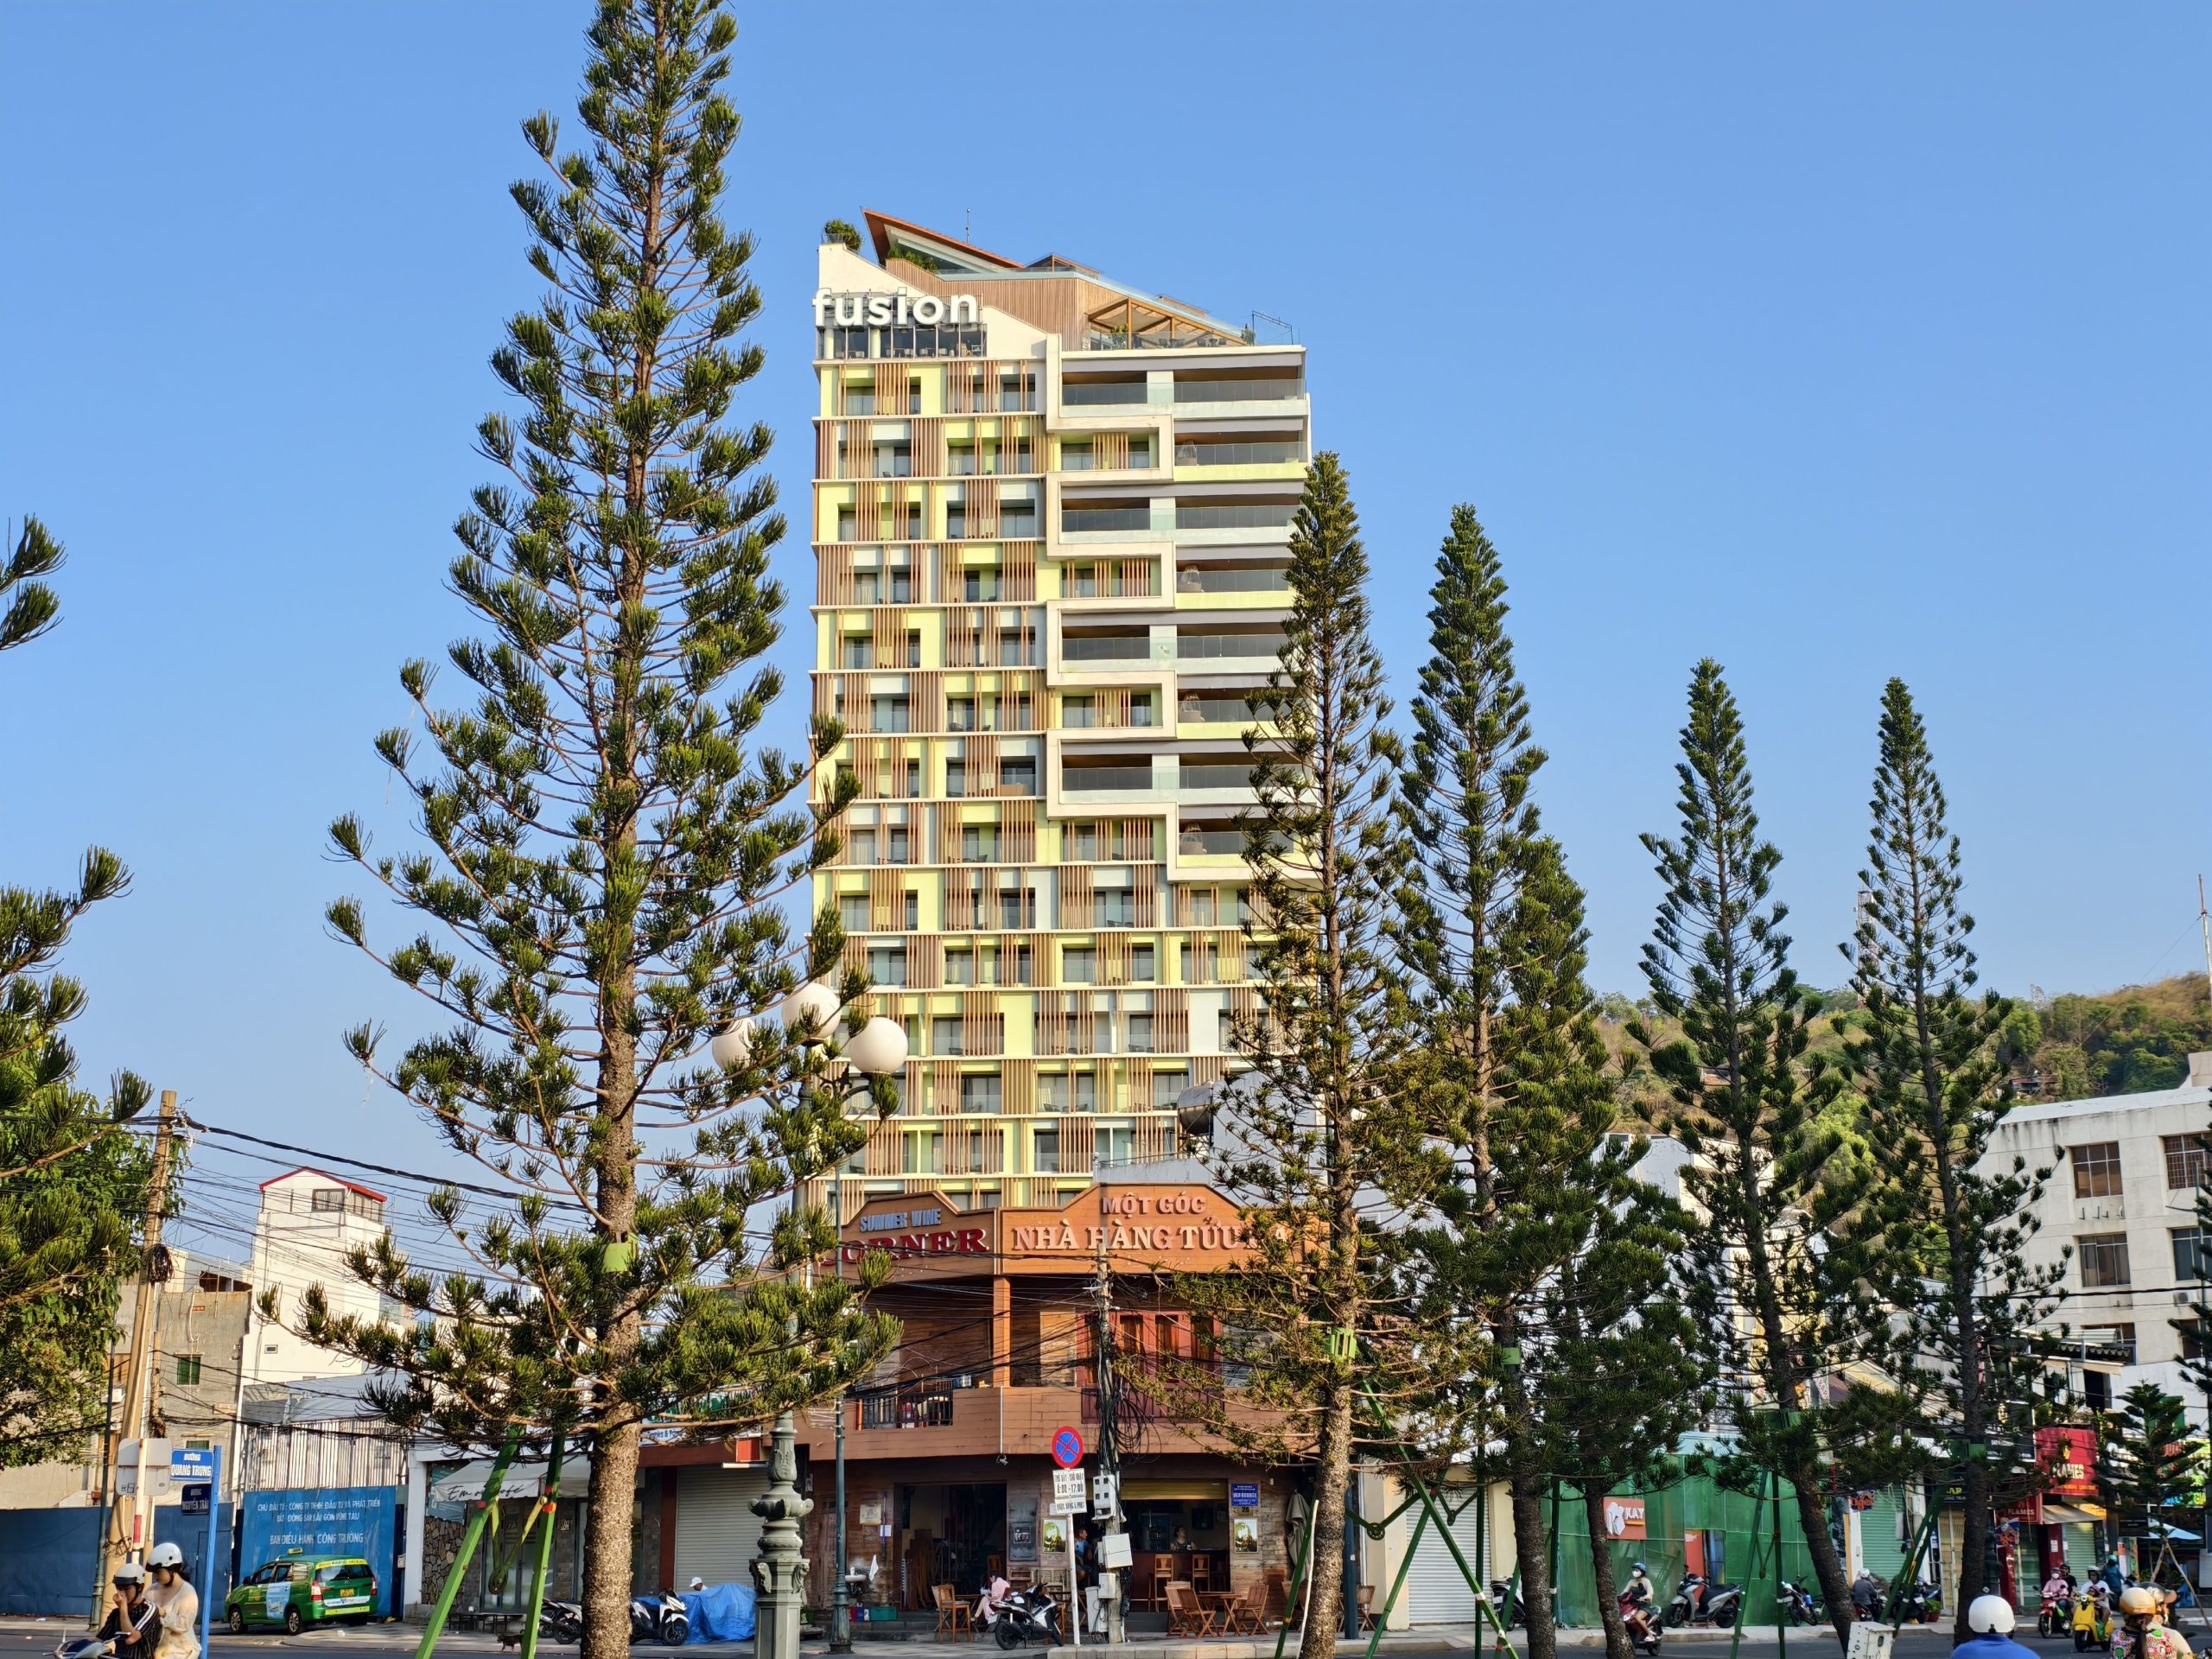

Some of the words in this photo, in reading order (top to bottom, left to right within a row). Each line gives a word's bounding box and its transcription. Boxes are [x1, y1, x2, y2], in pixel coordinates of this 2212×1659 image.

[812, 287, 977, 327] fusion
[1102, 1192, 1154, 1219] MỘT
[1157, 1190, 1207, 1215] GÓC
[860, 1212, 907, 1232] SUMMER
[912, 1208, 941, 1227] WINE
[1012, 1218, 1080, 1251] NHÀ
[1086, 1218, 1171, 1251] HÀNG
[820, 1228, 991, 1267] ORNER
[171, 1464, 192, 1478] QUANG
[192, 1465, 212, 1478] TRUNG
[448, 1484, 473, 1501] Em
